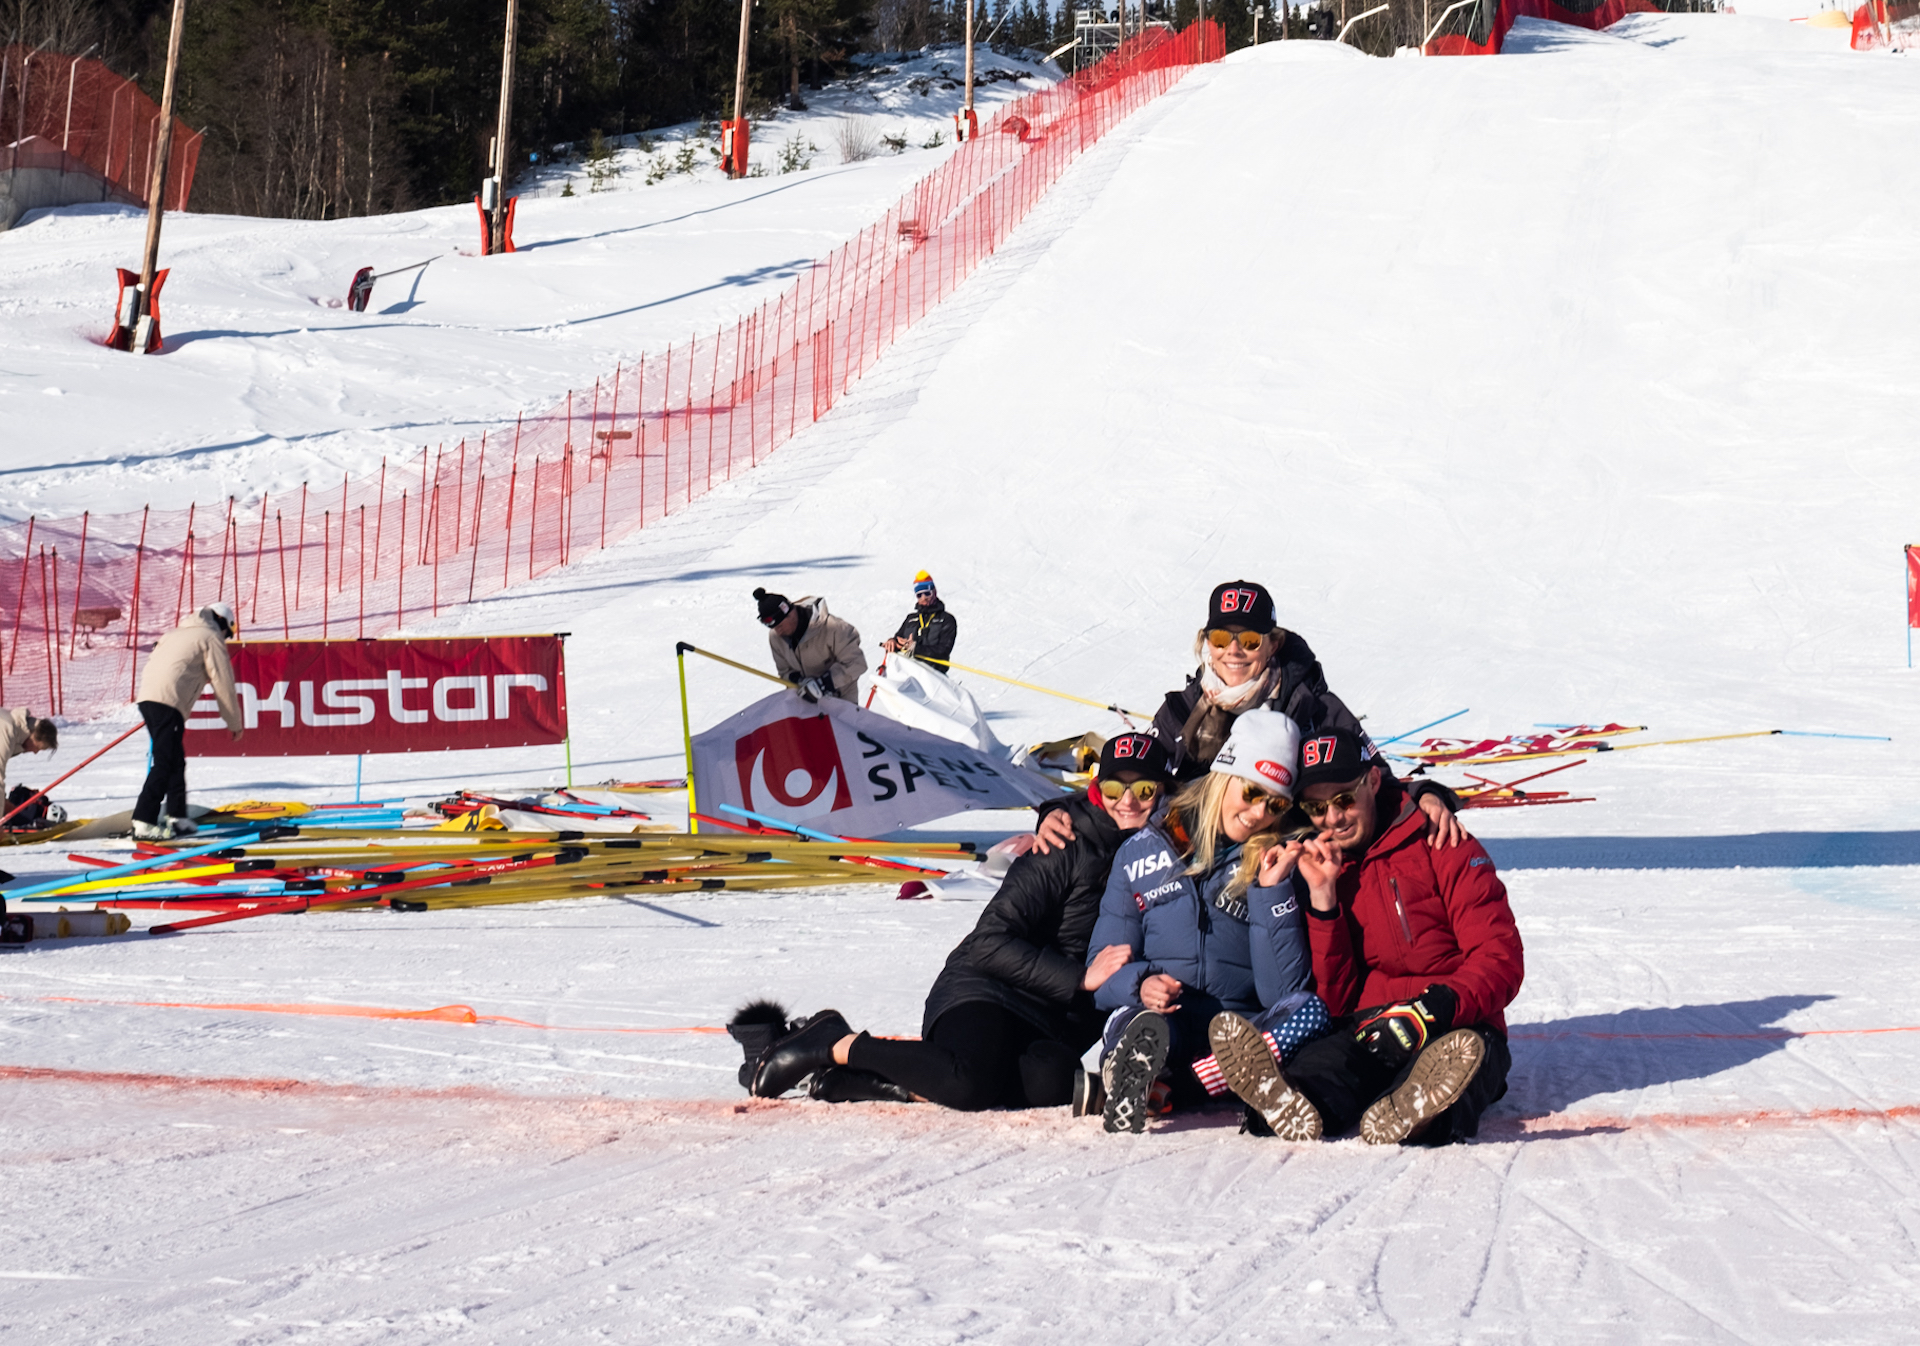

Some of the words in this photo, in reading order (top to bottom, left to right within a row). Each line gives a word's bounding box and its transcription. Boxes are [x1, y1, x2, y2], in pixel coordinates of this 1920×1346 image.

[1220, 587, 1258, 613] 87
[856, 730, 1012, 783] SVENS
[1114, 734, 1153, 760] 87
[1302, 736, 1337, 768] 87
[867, 761, 990, 801] SPEL
[1259, 761, 1291, 785] Barilla
[1123, 850, 1173, 882] VISA
[1143, 881, 1183, 902] TOYOTA
